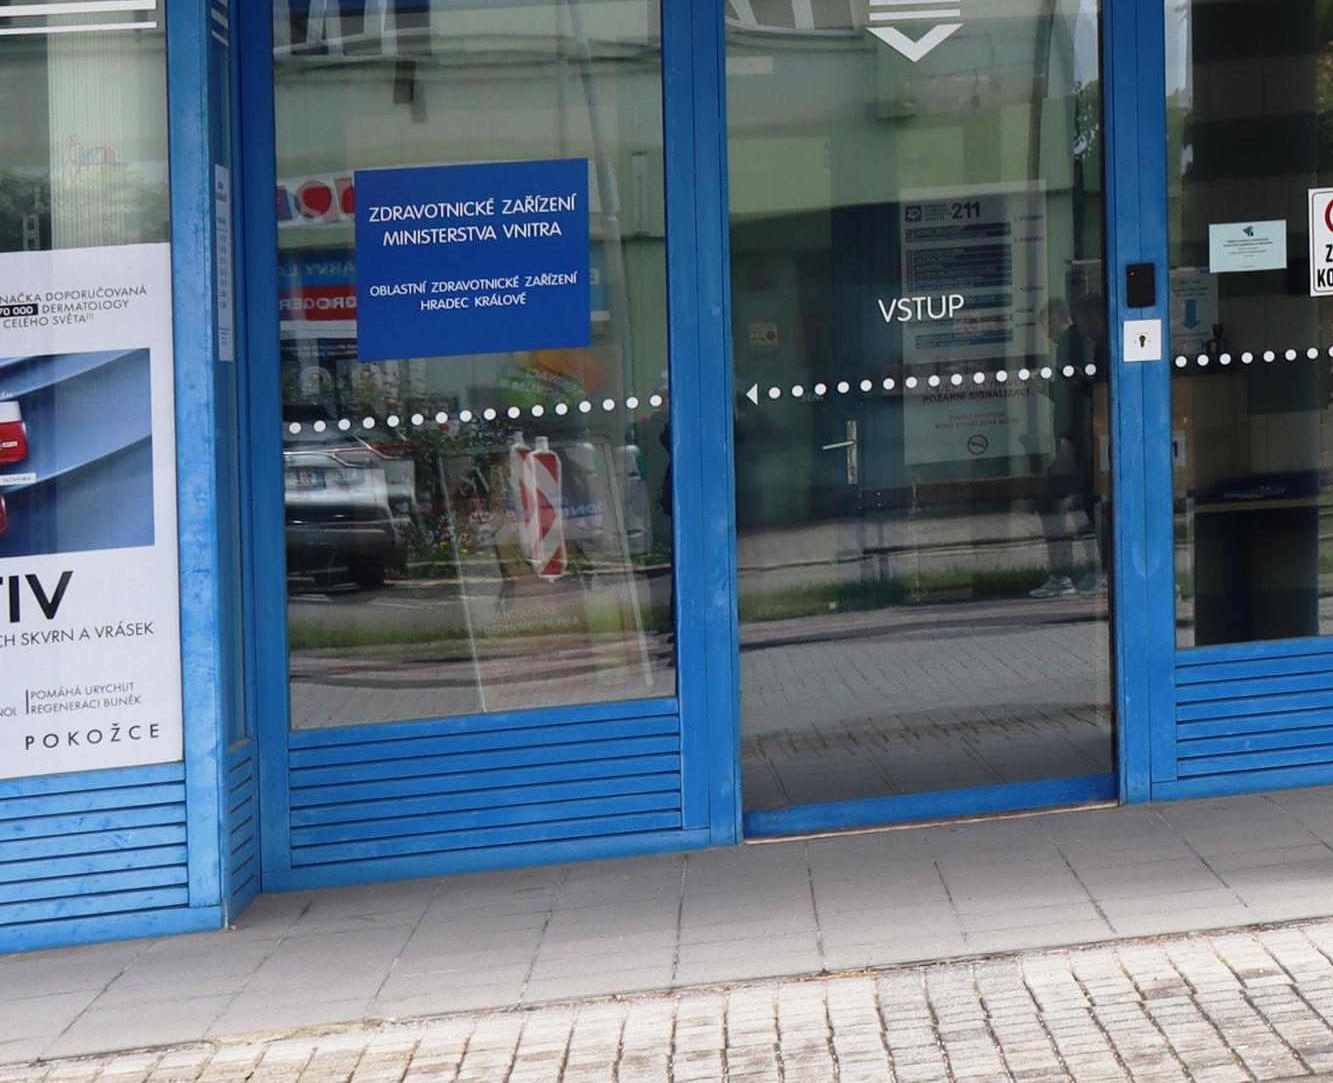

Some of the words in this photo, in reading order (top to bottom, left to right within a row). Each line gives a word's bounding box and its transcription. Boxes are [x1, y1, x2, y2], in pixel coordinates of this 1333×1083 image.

[369, 198, 495, 223] ZDRAVOTNICKÉ
[501, 193, 577, 215] ZAŘÍZENÍ
[951, 202, 980, 219] 211
[382, 225, 496, 246] MINISTERSTVA
[502, 221, 562, 239] VNITRA
[46, 285, 147, 302] DOPORUČOVANÁ
[370, 280, 427, 297] OBLASTNÍ
[431, 275, 519, 293] ZDRAVOTNICKÉ
[525, 271, 578, 287] ZAŘÍZENÍ
[13, 306, 33, 316] 000
[42, 299, 129, 314] DERMATOLOGY
[420, 297, 469, 311] HRADEC
[474, 291, 527, 307] KRÁLOVÉ
[878, 294, 965, 323] VSTUP
[3, 316, 49, 329] CELÉHO
[0, 570, 74, 623] IV
[21, 629, 74, 647] SKVRN
[79, 628, 91, 641] A
[95, 621, 155, 637] VRÁSEK
[31, 686, 82, 700] POMÁHÁ
[85, 682, 135, 695] URYCHLIT
[31, 700, 100, 715] REGENERACI
[104, 695, 141, 708] BUNĚK
[26, 723, 160, 750] POKOŽCE
